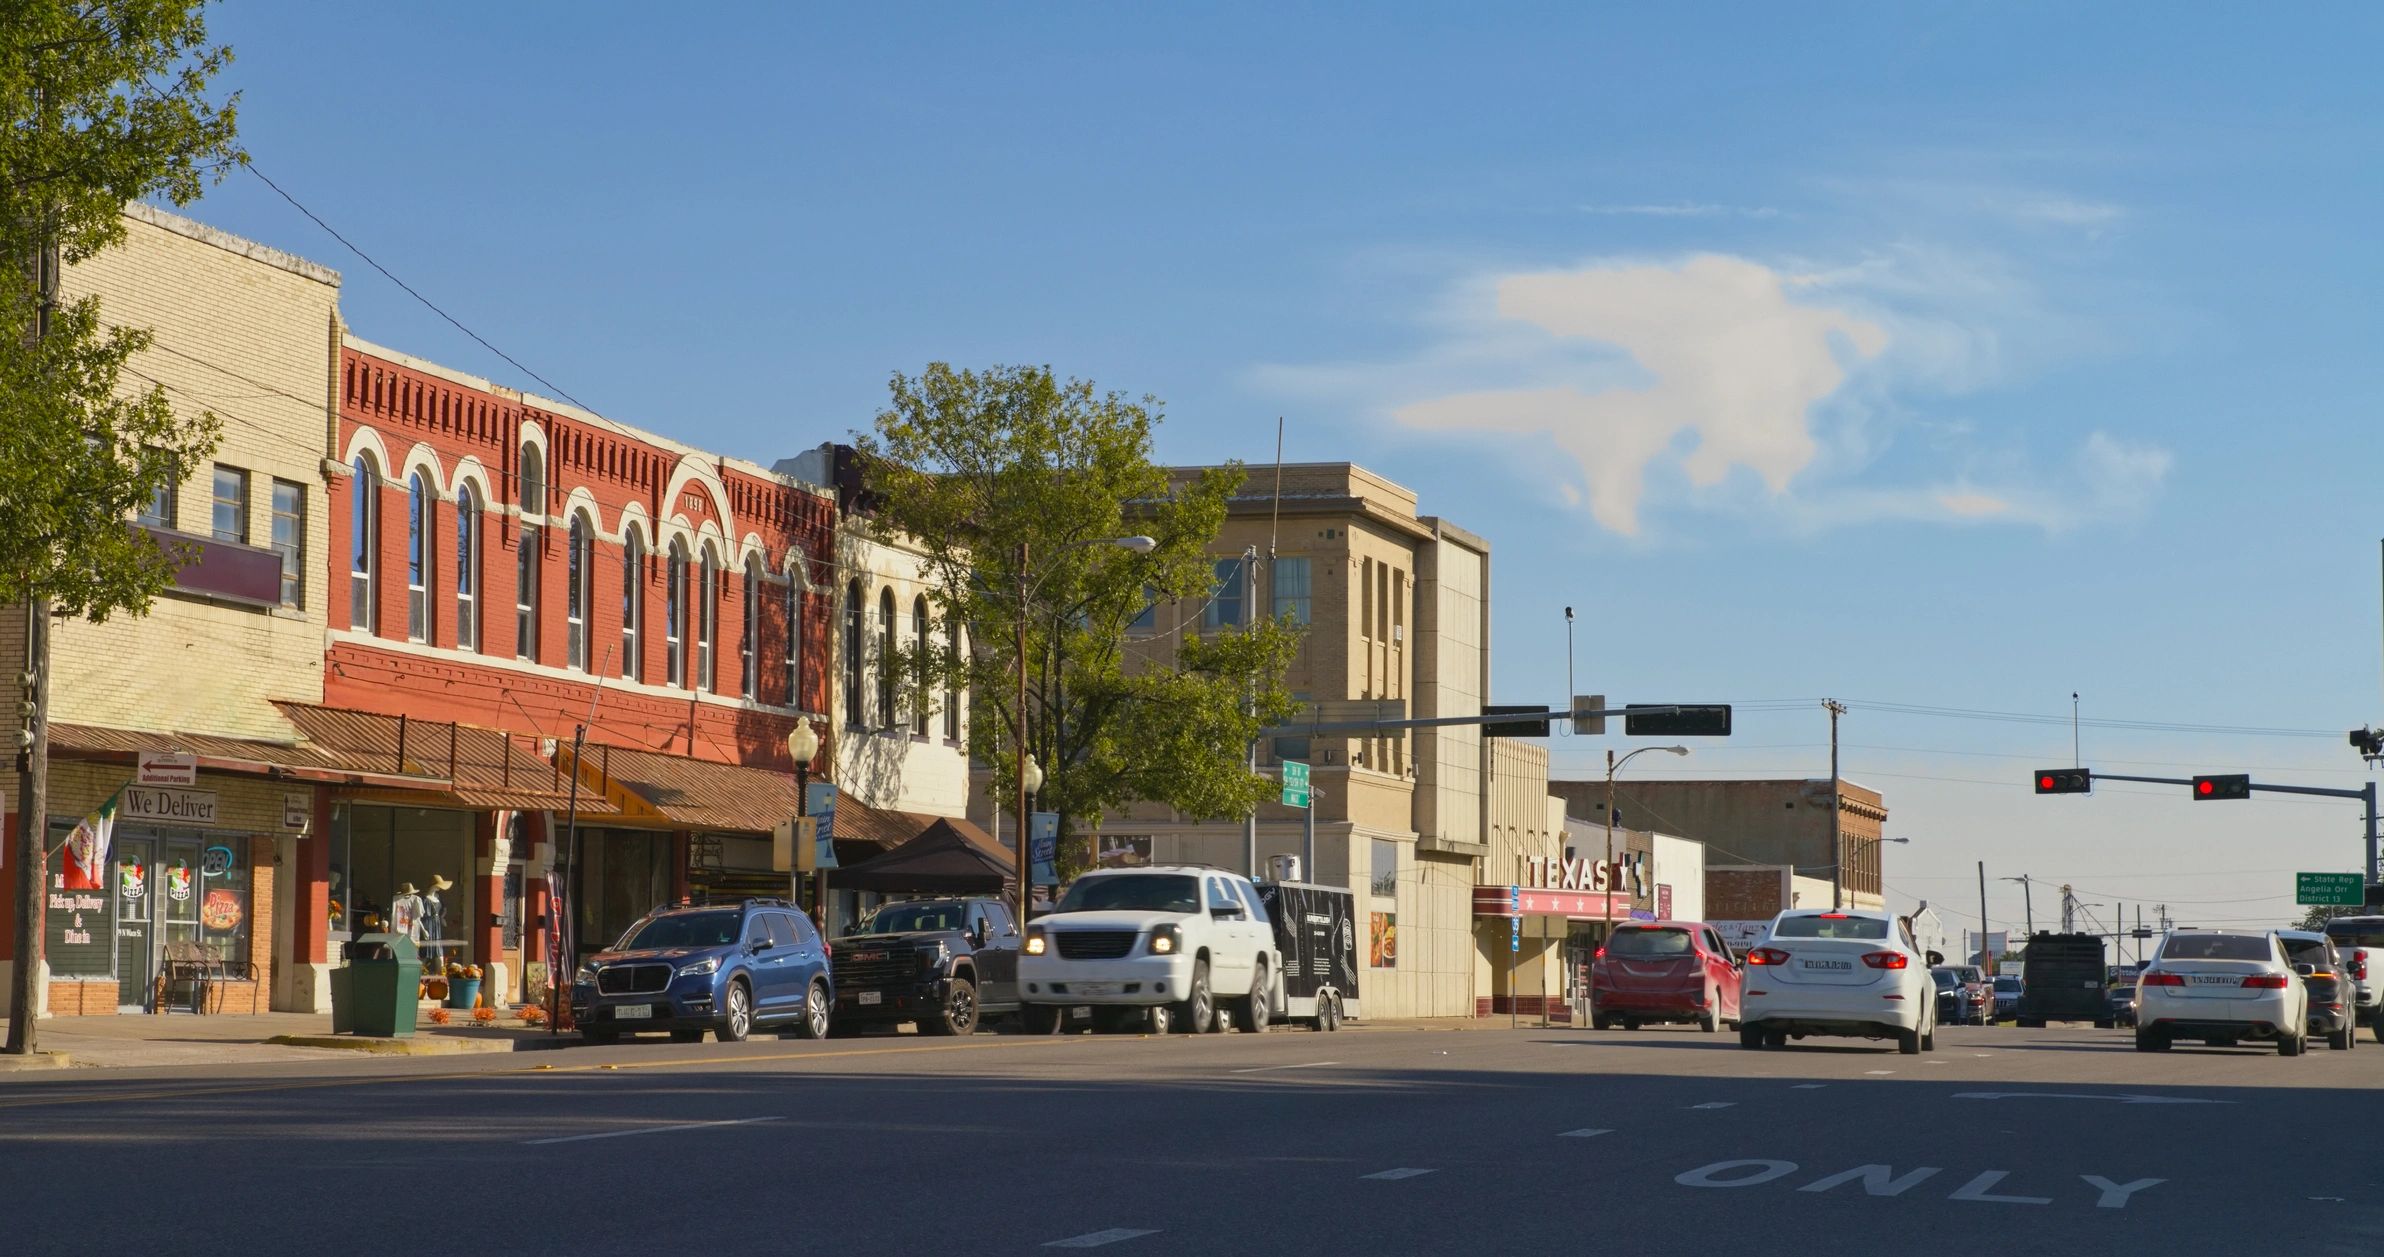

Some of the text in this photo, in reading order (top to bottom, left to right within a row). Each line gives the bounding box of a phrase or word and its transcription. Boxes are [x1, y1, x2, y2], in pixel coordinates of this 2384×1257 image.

[142, 774, 190, 784] Additional Parking
[127, 789, 213, 818] We Deliver
[1528, 855, 1608, 891] TEXAS
[2314, 875, 2354, 884] State Rep
[122, 886, 144, 896] PIZZA
[170, 889, 190, 899] PIZZA
[2300, 885, 2331, 894] Angelia
[75, 895, 103, 913] Delivery
[209, 892, 234, 915] Pizza
[74, 913, 83, 928] &
[852, 952, 885, 961] GMC
[1673, 1158, 2170, 1209] ONLY
